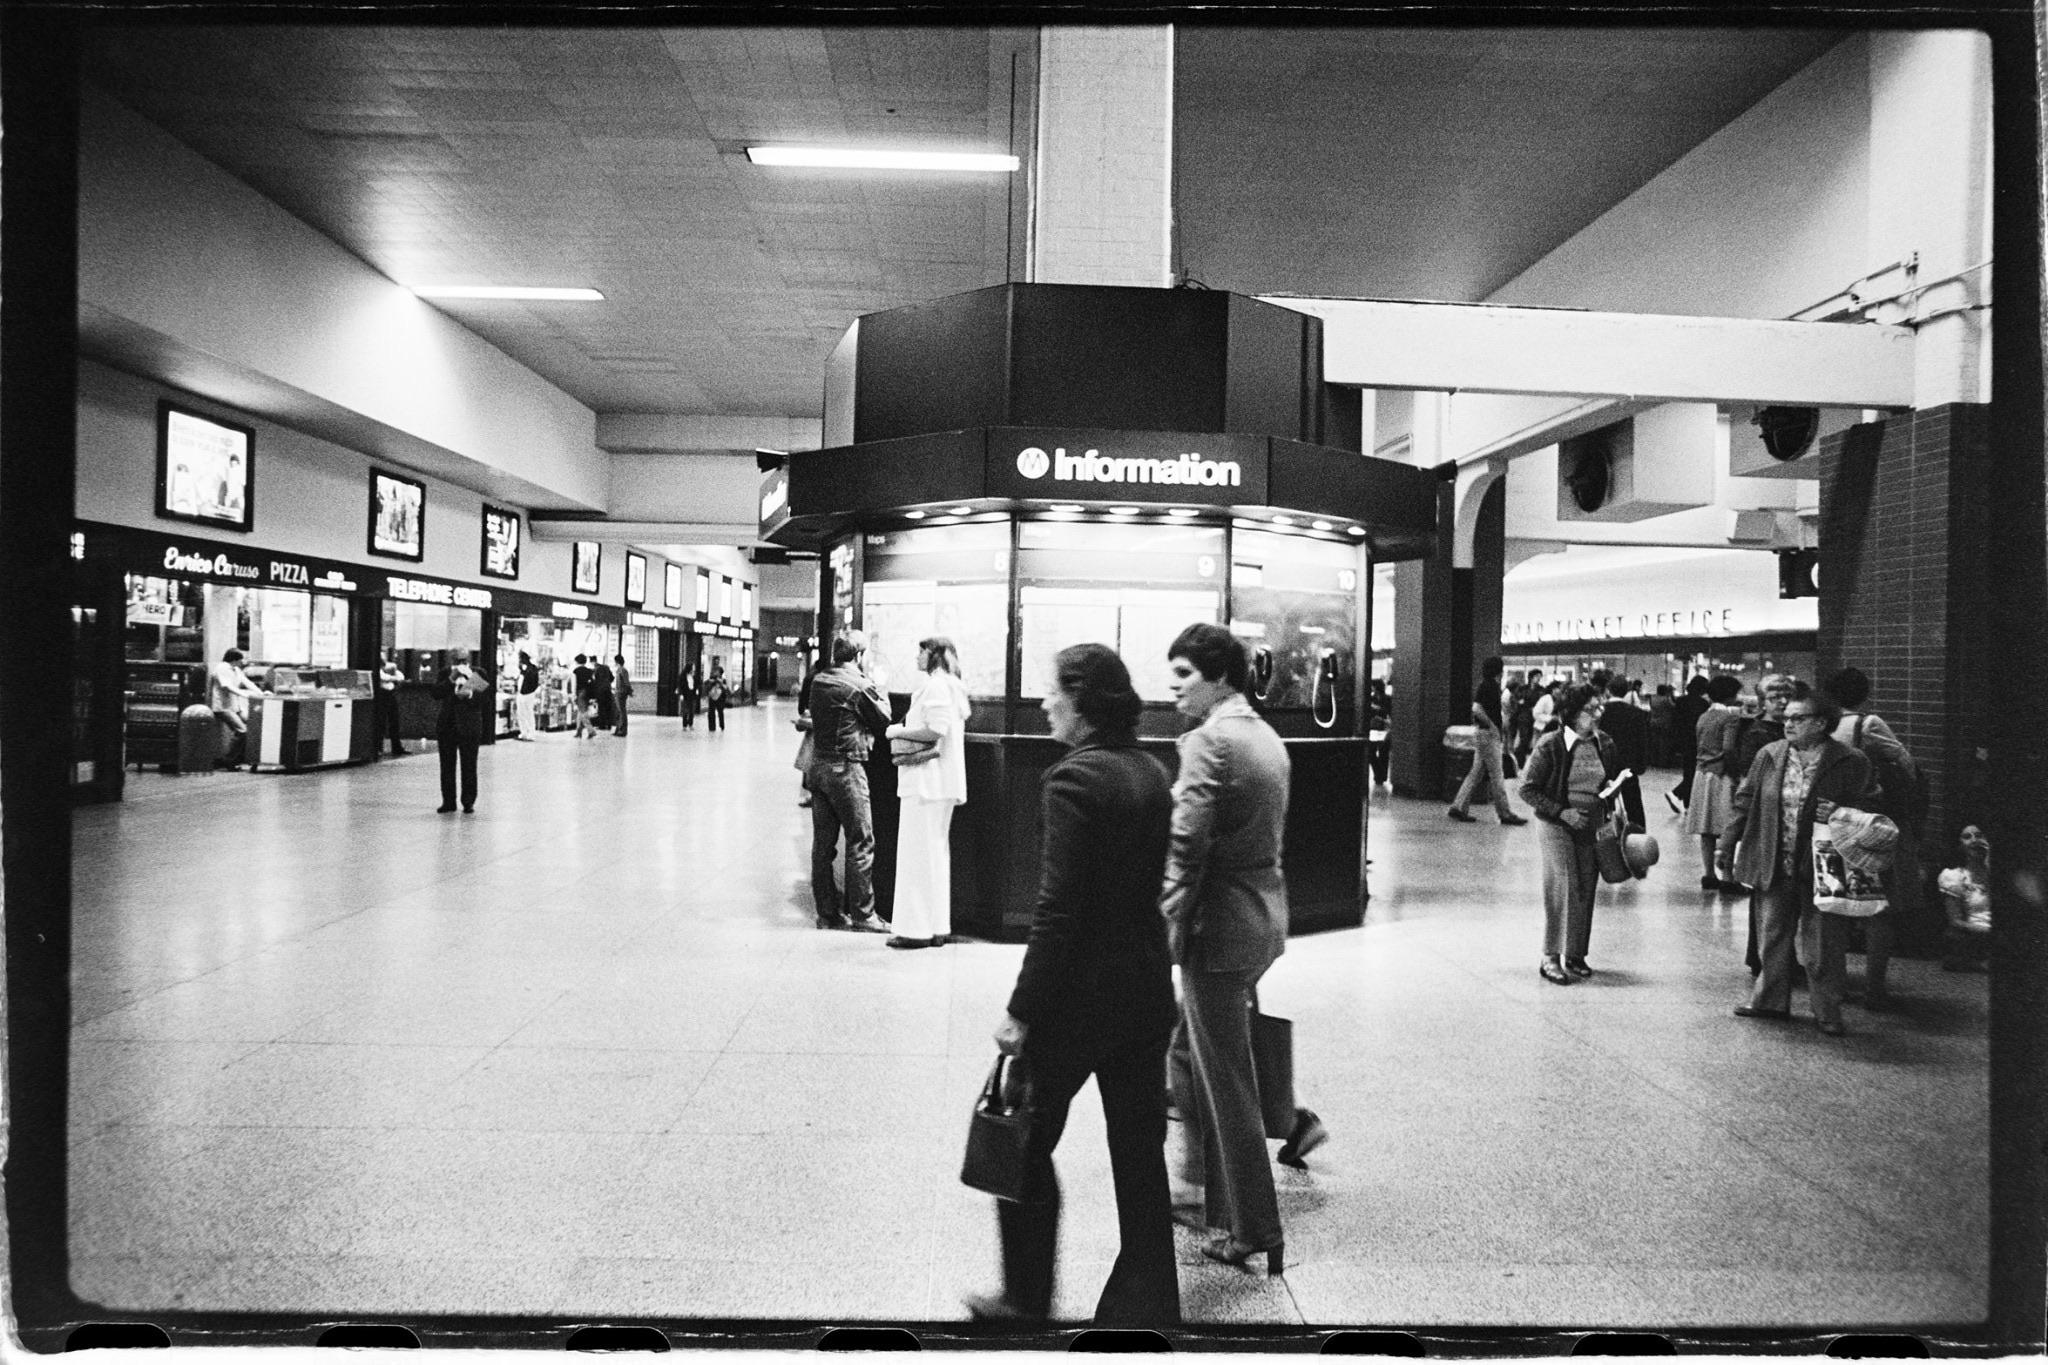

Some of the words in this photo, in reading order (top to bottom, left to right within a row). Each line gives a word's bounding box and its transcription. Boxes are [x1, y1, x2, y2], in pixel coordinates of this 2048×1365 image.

[1054, 448, 1241, 486] Information
[164, 547, 213, 573] Enrico
[213, 554, 260, 578] Caruso
[270, 561, 309, 585] PIZZA
[1198, 555, 1215, 578] 9
[1337, 570, 1356, 590] 10
[144, 603, 166, 615] HERO
[386, 577, 454, 604] TELEPHONE
[453, 587, 492, 609] CENTER
[1556, 615, 1625, 640] TICKET
[1640, 608, 1733, 638] OFFICE
